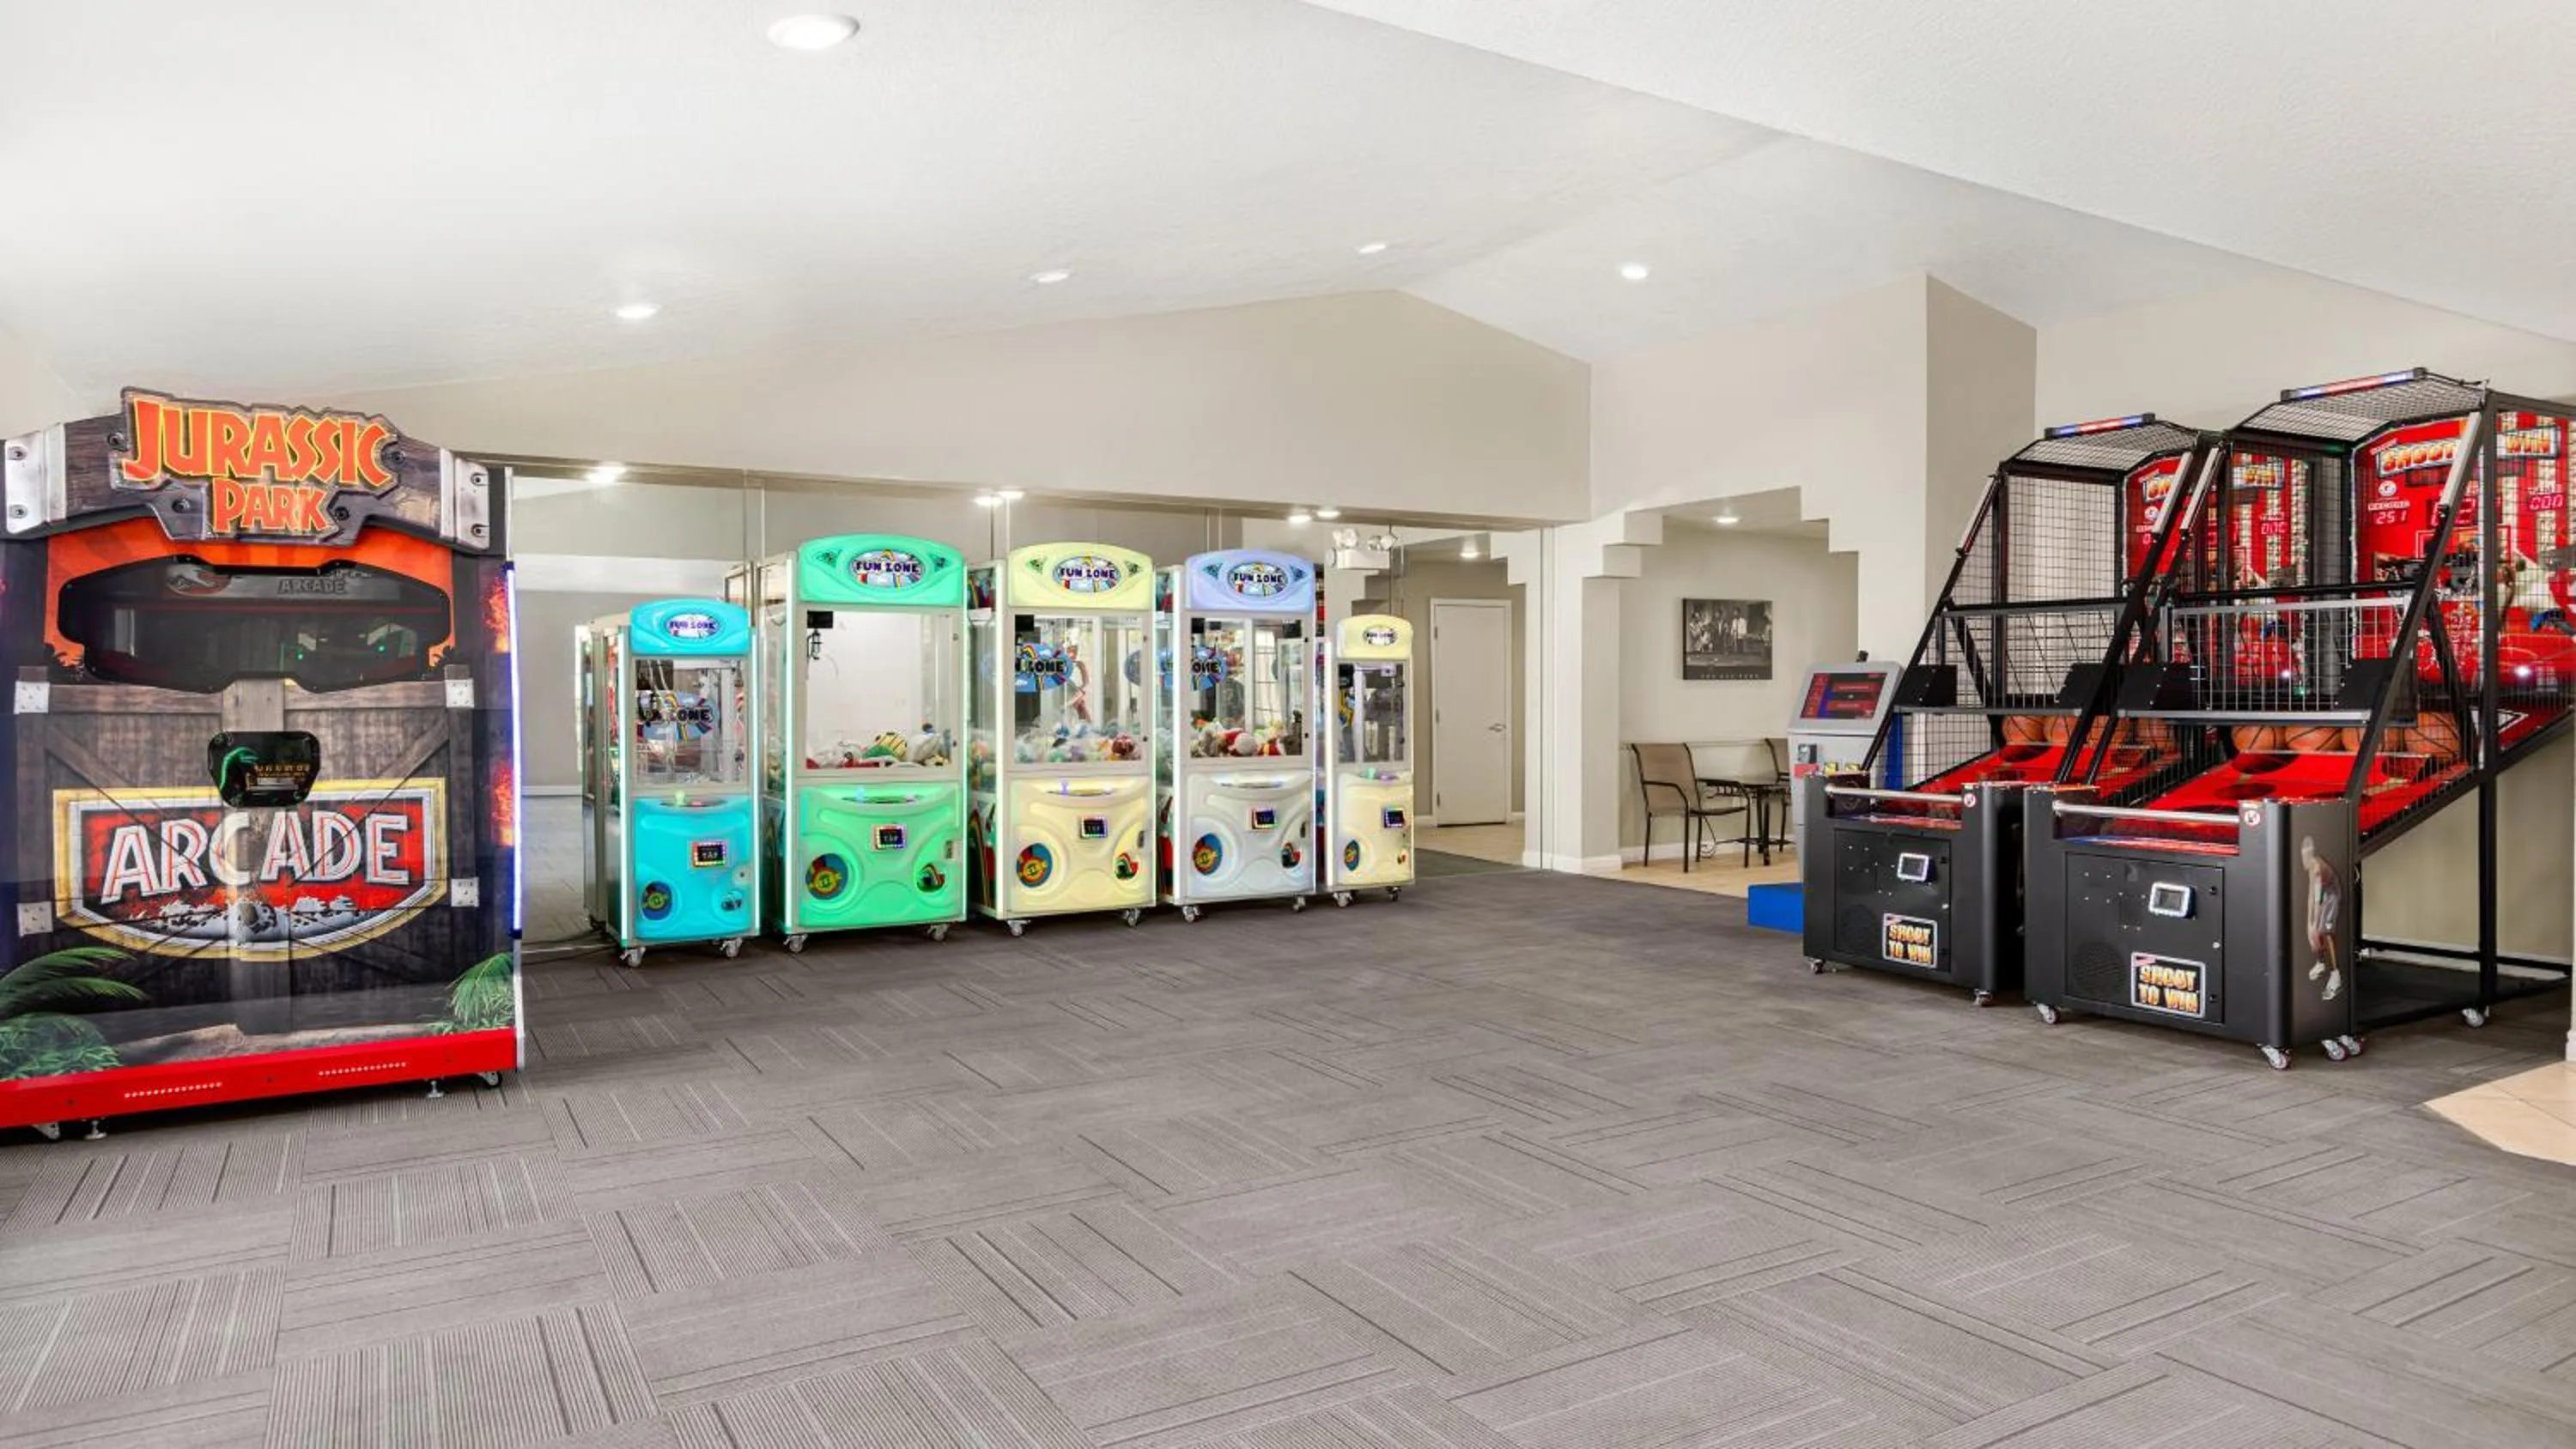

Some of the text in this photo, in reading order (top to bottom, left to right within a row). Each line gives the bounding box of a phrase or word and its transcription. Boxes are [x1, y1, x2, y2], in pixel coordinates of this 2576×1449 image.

[122, 397, 392, 488] JURASSIC
[212, 476, 331, 534] PARK
[856, 561, 920, 573] FUN ZONE
[1059, 567, 1115, 579] FUN ZONE
[1234, 573, 1283, 583] FUN ZONE
[276, 579, 347, 595] ARCADE
[1191, 661, 1220, 674] ONE
[670, 709, 714, 722] ONE
[100, 810, 411, 904] ARCADE
[1888, 924, 1931, 946] SHOOT
[1888, 940, 1932, 963] TO WIN
[2139, 965, 2197, 991] SHOOT
[2138, 983, 2199, 1012] TO WIN
